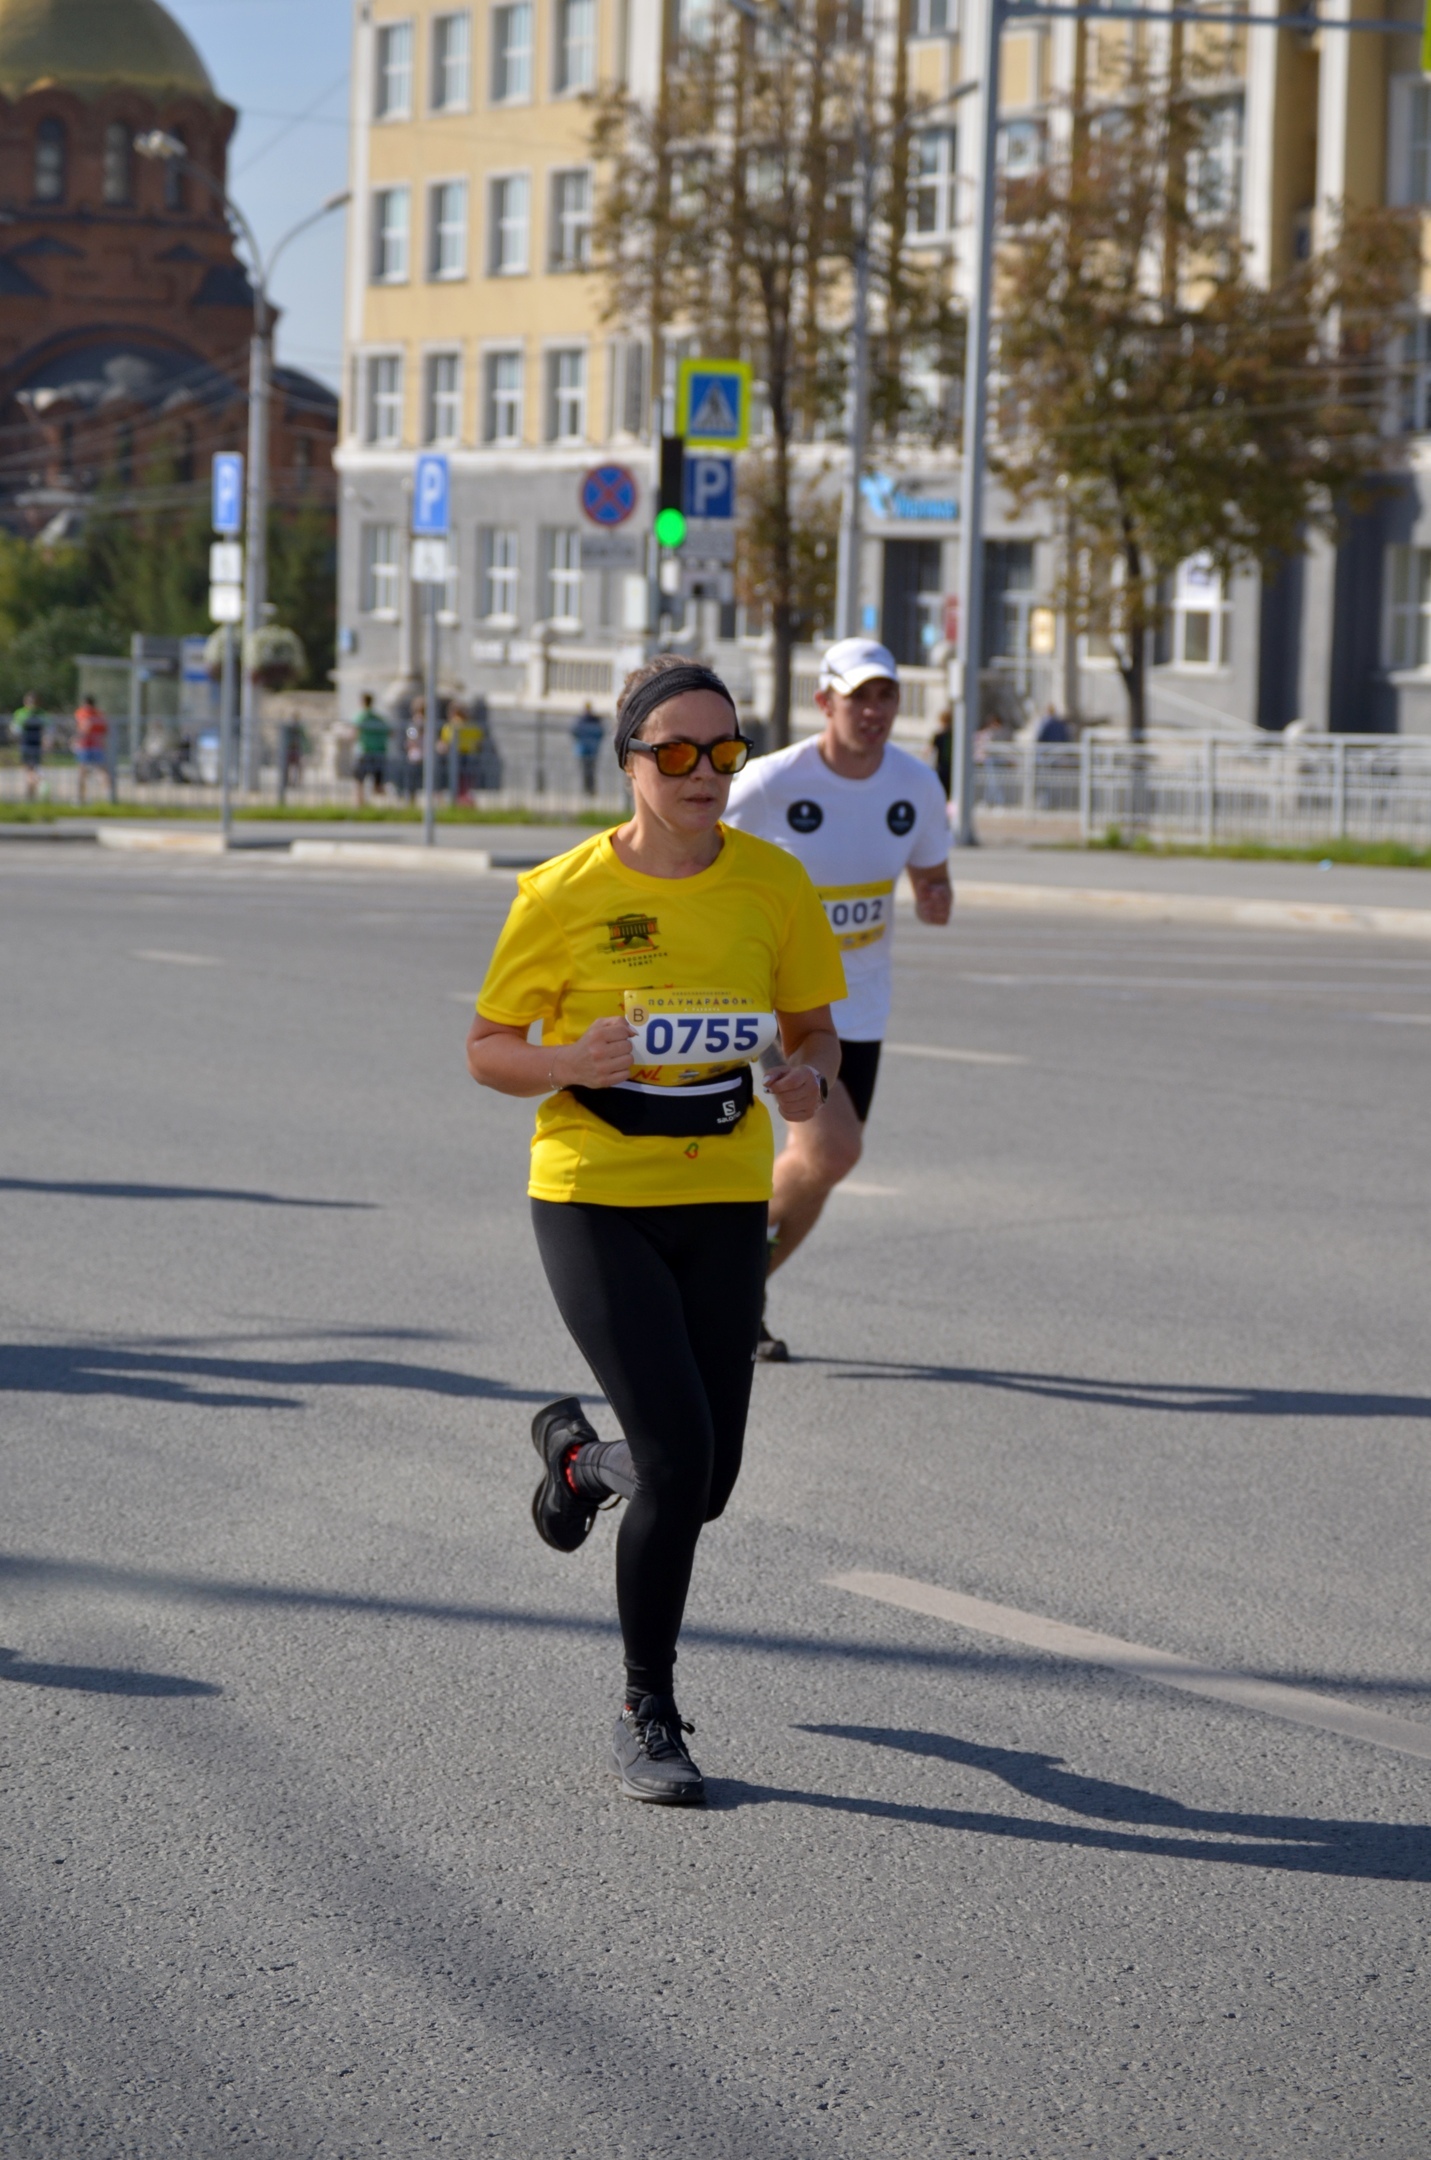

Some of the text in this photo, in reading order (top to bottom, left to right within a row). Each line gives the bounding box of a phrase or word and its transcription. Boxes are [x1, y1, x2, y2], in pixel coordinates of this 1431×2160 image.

[420, 461, 443, 522] P
[694, 460, 728, 514] P
[824, 899, 883, 926] 002
[648, 996, 748, 1007] ПОЛУМАРАФОН
[646, 1017, 759, 1055] 0755
[632, 1065, 663, 1081] NL
